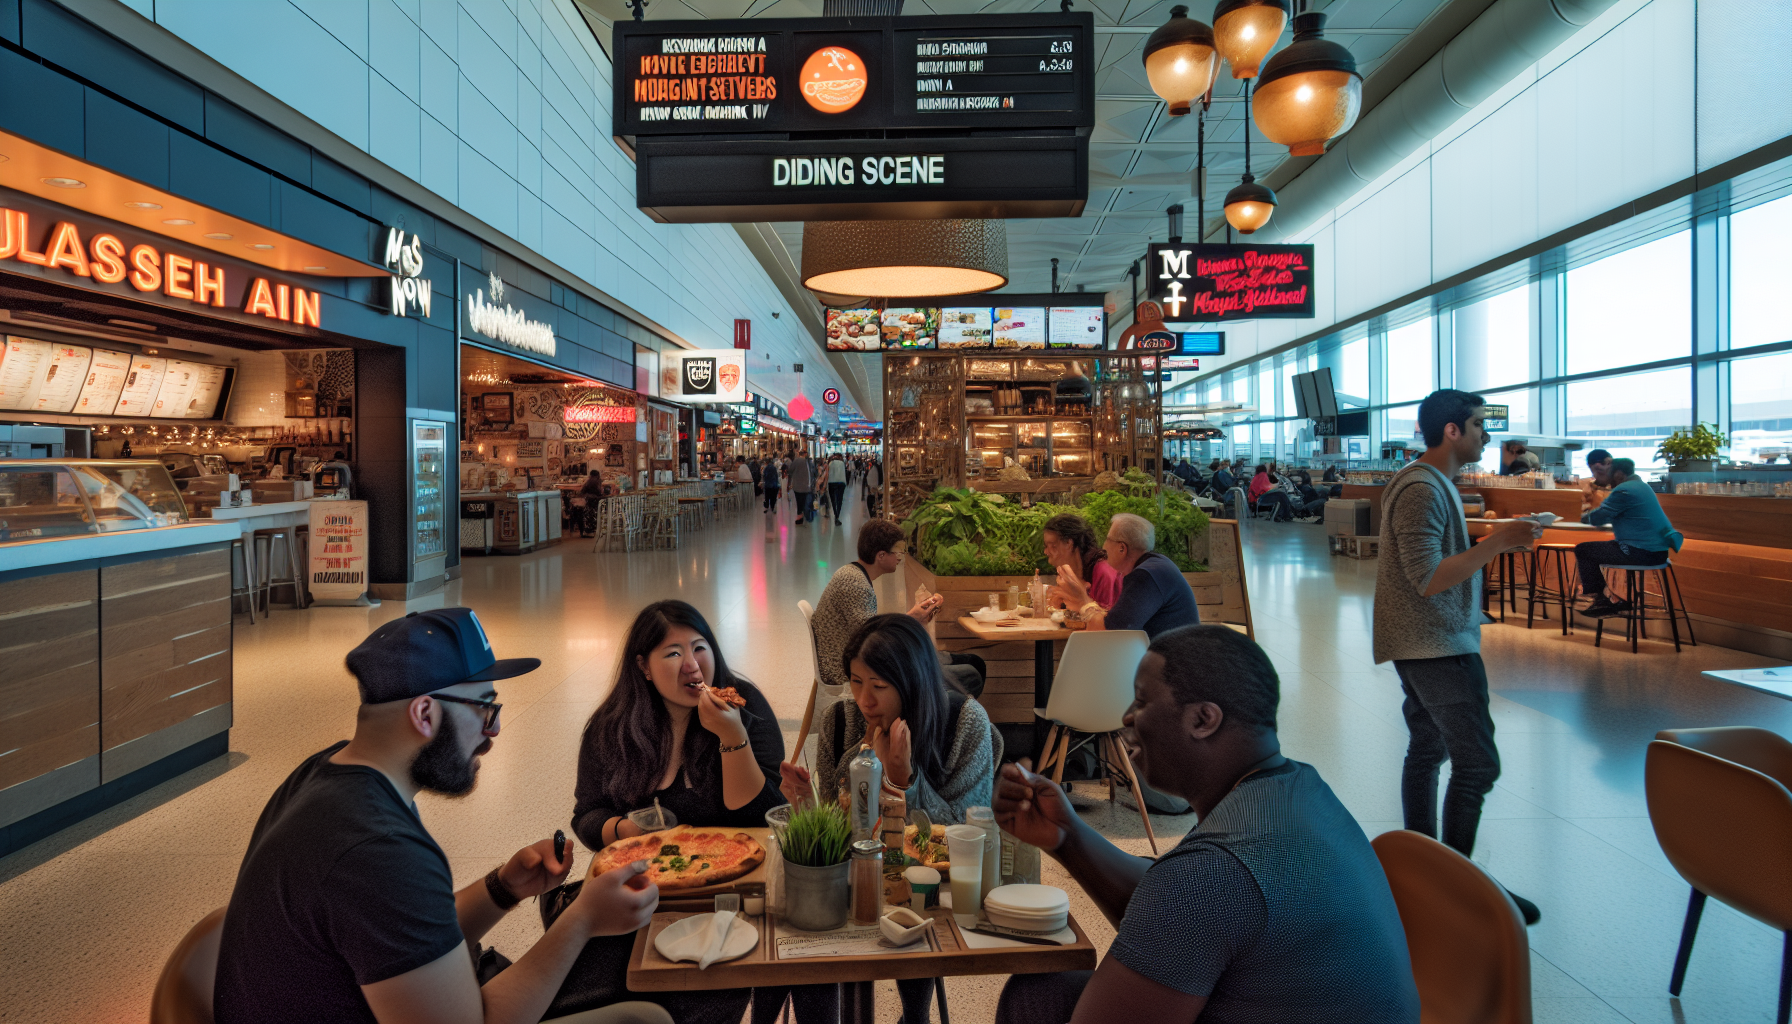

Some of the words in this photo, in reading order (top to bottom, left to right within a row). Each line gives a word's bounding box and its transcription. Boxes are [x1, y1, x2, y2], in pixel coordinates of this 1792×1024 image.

[773, 157, 855, 186] DIDING
[861, 156, 945, 185] SCENE
[244, 277, 321, 329] AIN
